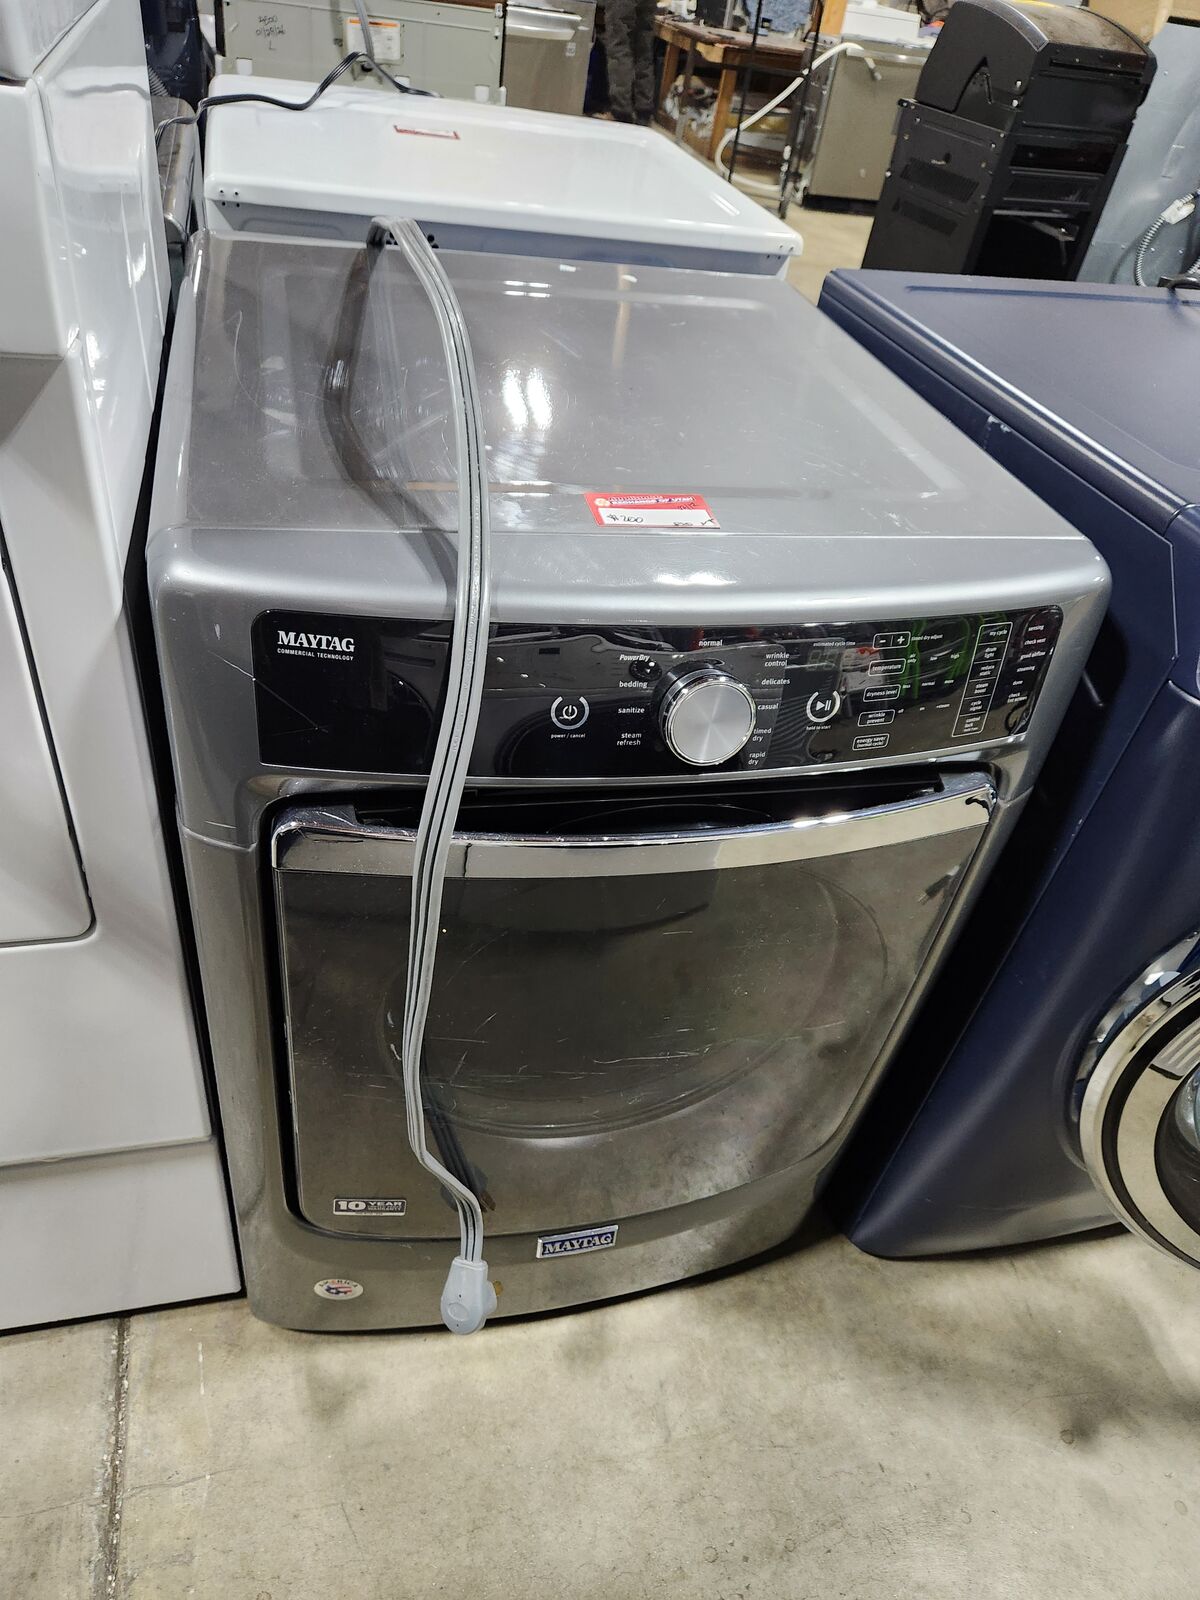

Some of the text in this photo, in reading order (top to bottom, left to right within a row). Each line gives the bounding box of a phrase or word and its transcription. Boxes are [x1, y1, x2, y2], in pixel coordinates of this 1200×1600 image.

[277, 630, 355, 652] MAYTAG
[277, 648, 354, 661] COMMERCIAL TECHNOLOGY
[619, 654, 650, 662] PowerDry
[619, 681, 648, 689] bedding
[338, 1201, 366, 1210] 10
[544, 1234, 612, 1254] MAYTAG
